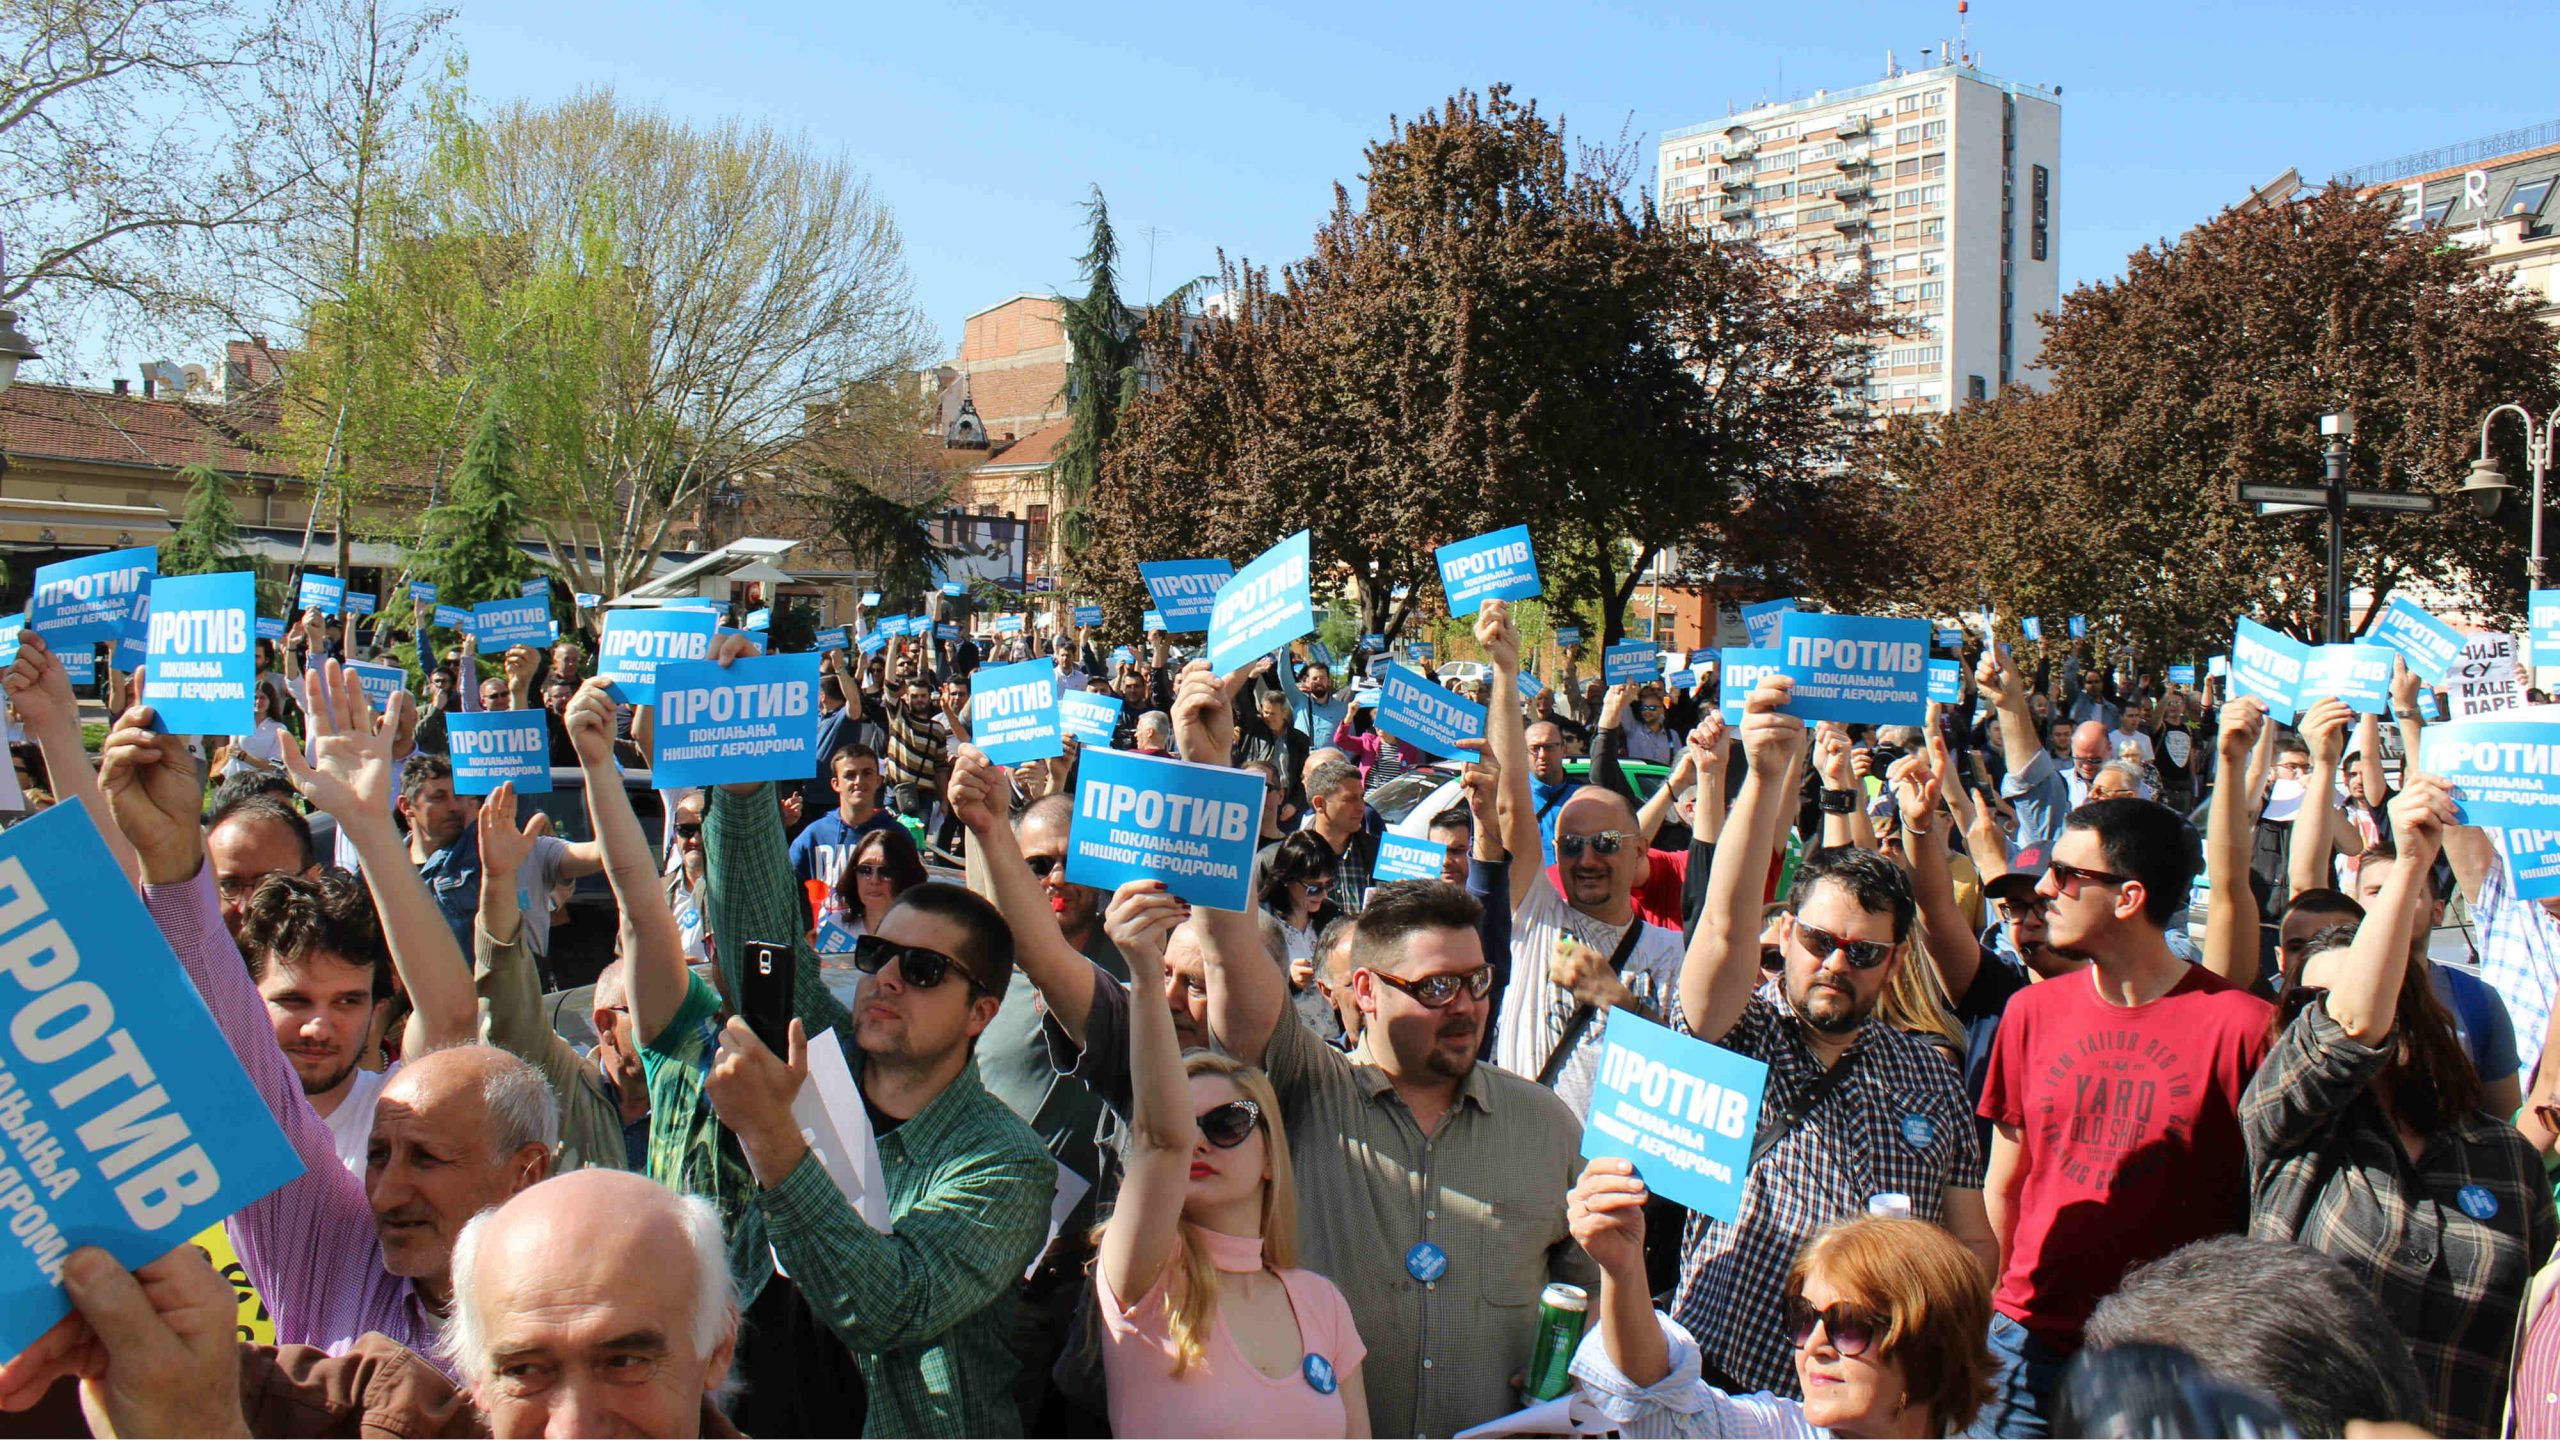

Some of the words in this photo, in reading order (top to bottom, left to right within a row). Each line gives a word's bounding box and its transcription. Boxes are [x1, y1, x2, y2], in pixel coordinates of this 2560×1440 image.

[1443, 541, 1529, 582] ПРОТИВ
[1213, 554, 1304, 631] ПРОТИВ
[1482, 573, 1533, 592] АЕРОДРОМА
[57, 597, 126, 616] ПОКЛАЊАЊА
[478, 608, 546, 628] ПРОТИВ
[148, 608, 246, 655] ПРОТИВ
[605, 629, 707, 659] ПРОТИВ
[2387, 609, 2458, 661] ПРОТИВ
[1608, 650, 1656, 666] ПРОТИВ
[1788, 636, 1923, 673] ПРОТИВ
[2460, 641, 2511, 661] ЧИЈЕ
[160, 661, 222, 678] ПОКЛАЊАЊА
[1813, 672, 1895, 688] ПОКЛАЊАЊА
[2461, 662, 2492, 679] СУ
[181, 682, 245, 701] АЕРОДРОМА
[975, 680, 1053, 721] ПРОТИВ
[1788, 685, 1841, 699] НИШКОГ
[1842, 688, 1918, 703] АЕРОДРОМА
[2462, 680, 2516, 698] НАШЕ
[661, 681, 809, 726] ПРОТИВ
[1061, 700, 1116, 723] ПРОТИВ
[1387, 677, 1479, 736] ПРОТИВ
[2464, 696, 2519, 715] ПАРЕ
[1383, 707, 1420, 729] НИШКОГ
[1403, 706, 1457, 739] ПОКЛАЊАЊА
[450, 727, 542, 754] ПРОТИВ
[690, 723, 777, 743] ПОКЛАЊАЊА
[468, 755, 524, 766] ПОКЛАЊАЊА
[663, 744, 719, 761] НИШКОГ
[719, 737, 805, 757] АЕРОДРОМА
[2426, 741, 2560, 776] ПРОТИ
[457, 767, 488, 777] НИШКОГ
[488, 766, 543, 778] АЕРОДРОМА
[2452, 774, 2544, 791] ПОКЛАЊАЊА
[1082, 779, 1250, 842] ПРОТИВ
[1109, 828, 1210, 858] ПОКЛАЊАЊА
[1381, 842, 1441, 868] ПРОТИВ
[1079, 840, 1141, 865] НИШКОГ
[1141, 852, 1238, 880] АЕРОДРОМА
[2076, 1030, 2140, 1056] TAILOR
[1601, 1042, 1750, 1139] ПРОТИВ
[2074, 1073, 2156, 1124] YARD
[2070, 1116, 2104, 1145] OLD
[2108, 1118, 2146, 1151] SHIP
